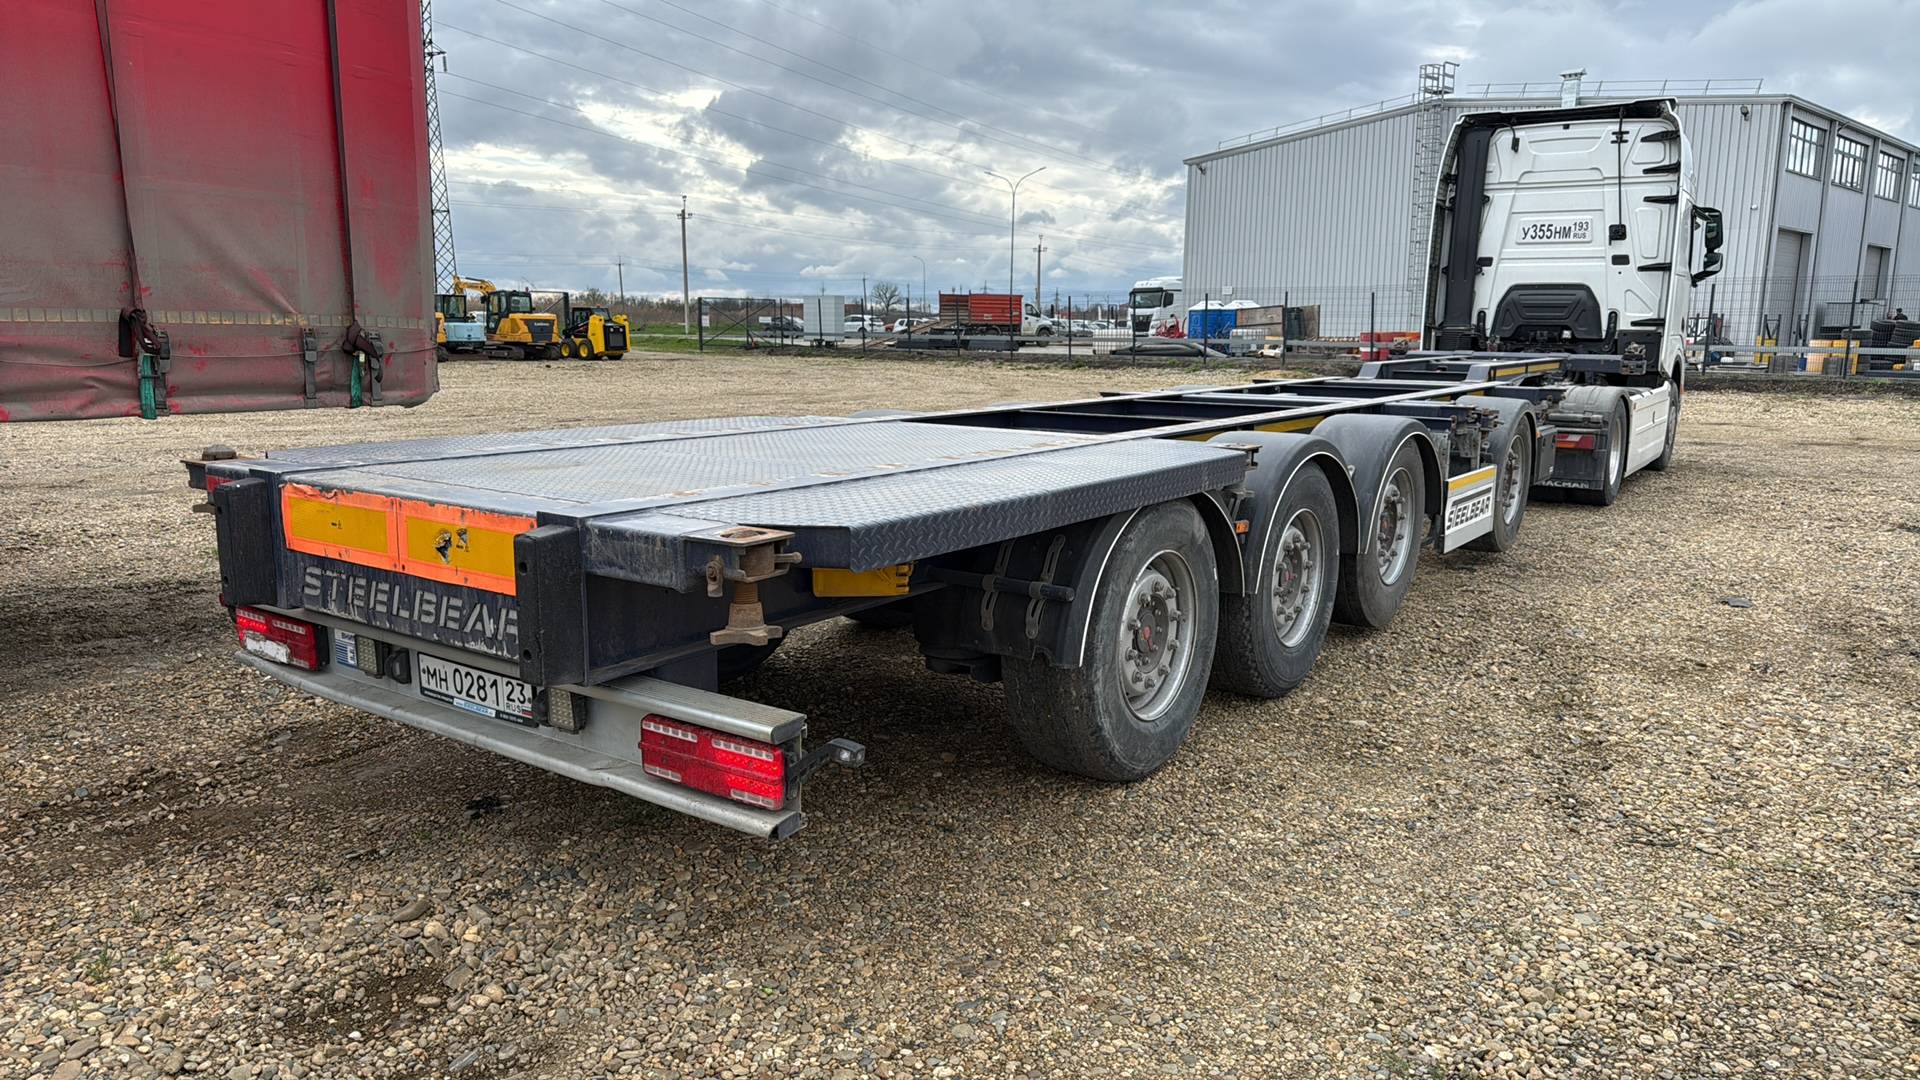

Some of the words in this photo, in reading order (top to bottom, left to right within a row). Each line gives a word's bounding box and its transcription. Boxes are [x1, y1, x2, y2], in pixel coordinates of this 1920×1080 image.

[1573, 221, 1590, 231] 193
[452, 667, 500, 707] 0281
[505, 680, 527, 704] 23
[505, 701, 522, 714] RUS
